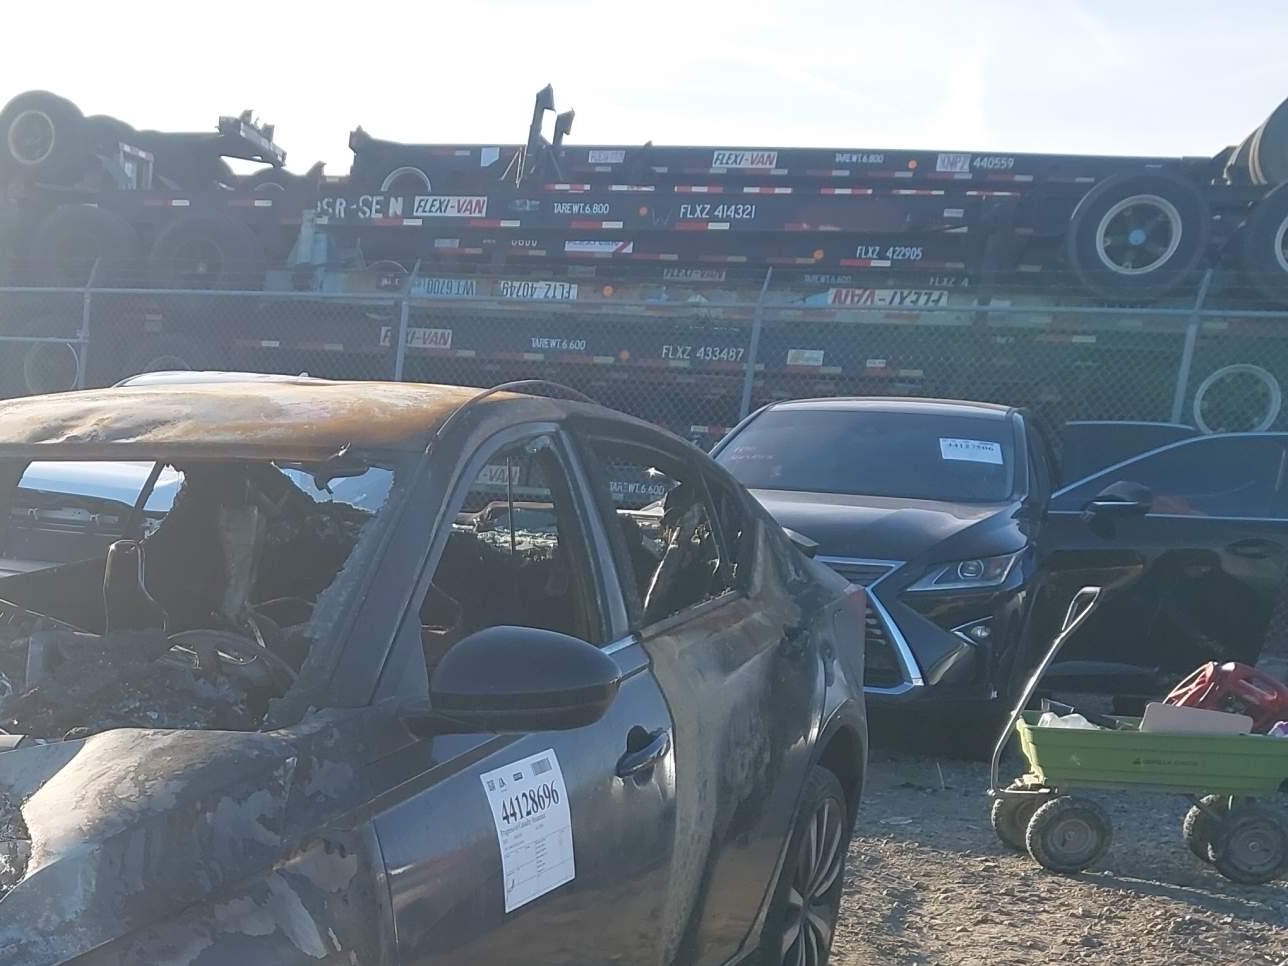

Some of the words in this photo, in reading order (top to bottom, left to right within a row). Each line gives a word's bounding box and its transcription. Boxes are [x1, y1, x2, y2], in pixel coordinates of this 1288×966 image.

[714, 152, 776, 168] FLEXI-VAN
[973, 157, 1014, 169] 440559
[415, 198, 486, 216] FLEXI-VAN
[679, 204, 710, 218] FLXZ
[713, 205, 756, 219] 414321
[856, 245, 879, 259] FLXZ
[886, 246, 923, 261] 422905
[662, 345, 692, 359] FLXZ
[696, 347, 745, 361] 433487
[501, 779, 560, 825] 44128696
